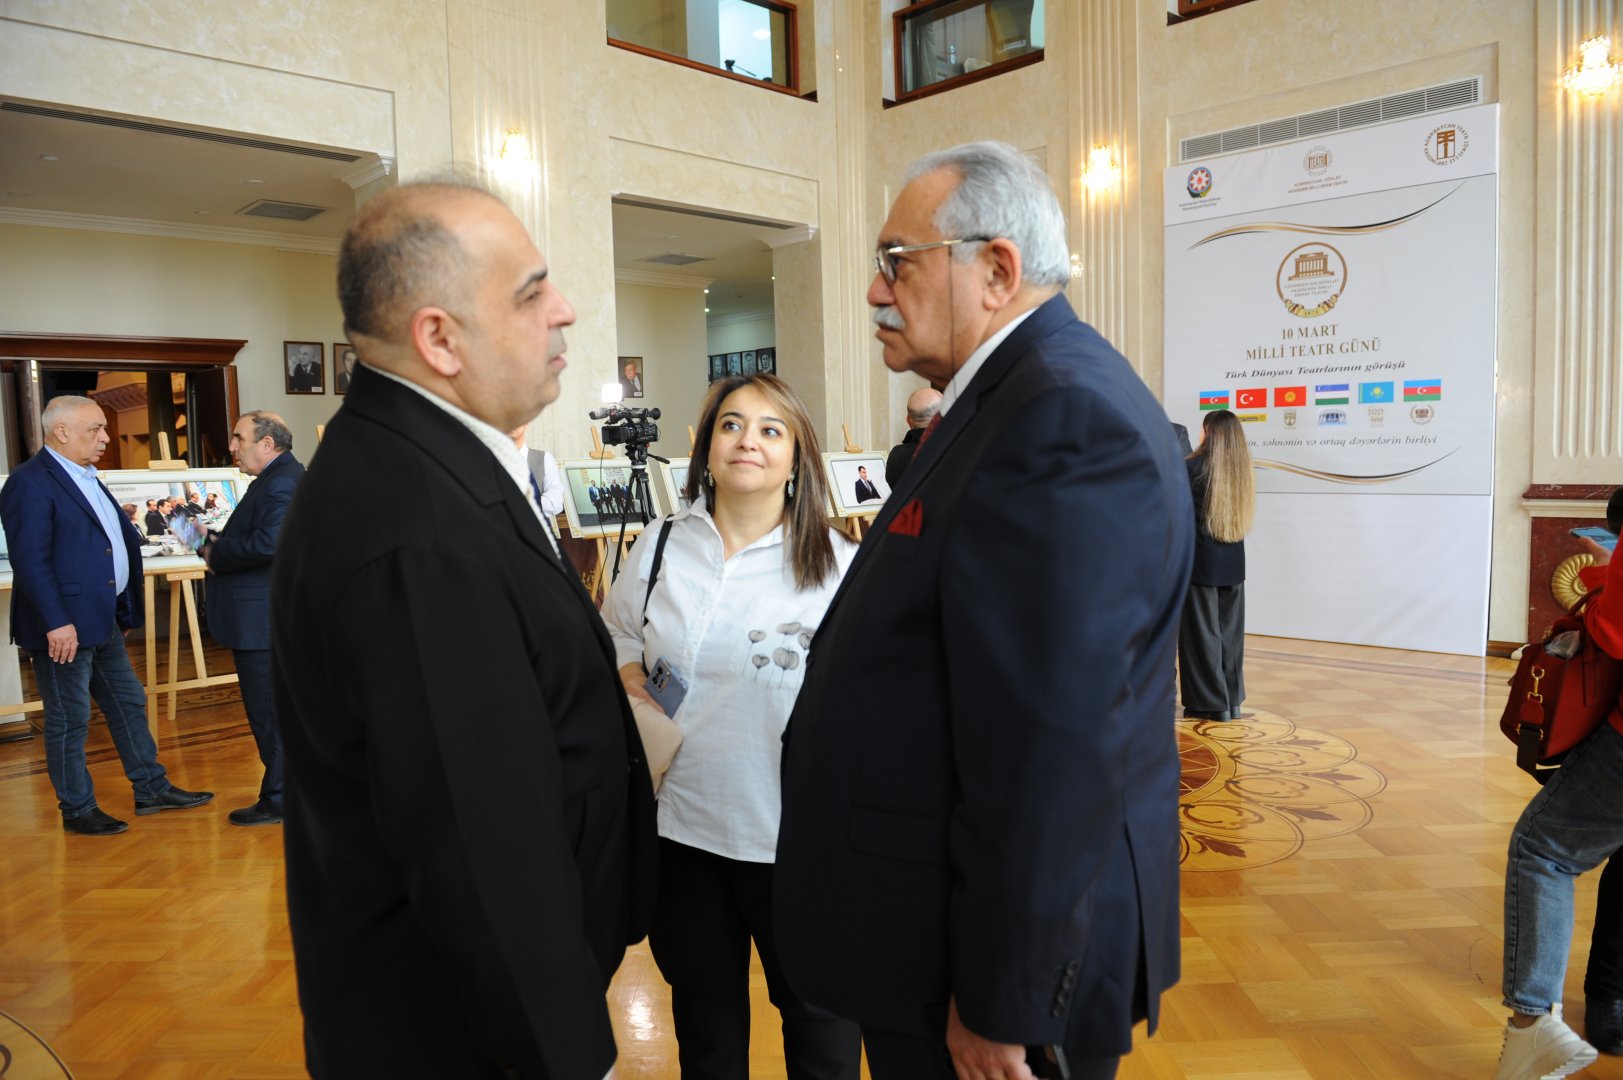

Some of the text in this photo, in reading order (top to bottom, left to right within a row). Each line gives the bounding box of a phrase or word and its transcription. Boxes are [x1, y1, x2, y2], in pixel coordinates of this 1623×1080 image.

[1282, 324, 1338, 340] 10 MART
[1246, 337, 1381, 360] MİLLİ TEATR GÜNÜ
[1225, 360, 1406, 379] Türk Dünyası Teatrlarının görüşü
[1248, 439, 1259, 448] in,
[1262, 437, 1303, 446] səhnənin
[1319, 437, 1346, 448] ortaq
[1349, 435, 1401, 448] dəyərlərin
[1405, 434, 1438, 447] birliyi
